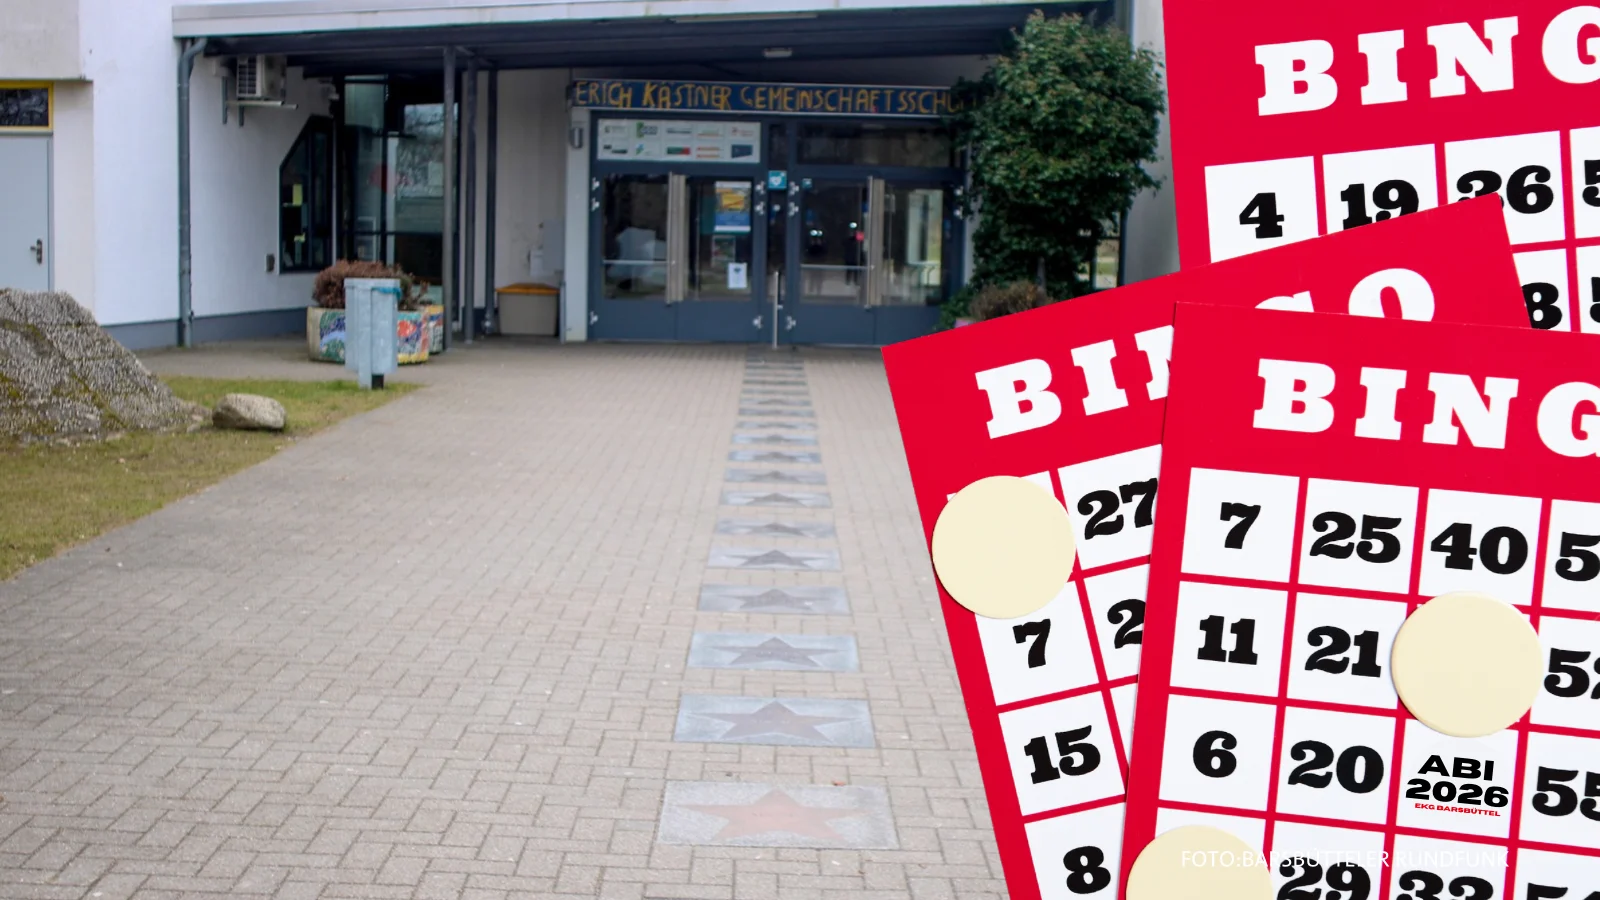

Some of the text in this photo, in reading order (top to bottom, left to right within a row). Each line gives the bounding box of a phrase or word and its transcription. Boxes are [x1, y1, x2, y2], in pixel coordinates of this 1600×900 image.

[575, 80, 632, 109] ERICH
[1239, 192, 1284, 239] 4
[1340, 179, 1419, 230] 19
[1077, 477, 1158, 540] 27
[1220, 502, 1261, 550] 7
[1309, 511, 1402, 564] 25
[1430, 522, 1528, 575] 40
[1012, 618, 1051, 669] 7
[1197, 614, 1258, 666] 11
[1304, 625, 1382, 678] 21
[1023, 725, 1101, 785] 15
[1192, 730, 1237, 778] 6
[1287, 740, 1385, 794] 20
[1417, 755, 1495, 781] ABI
[1405, 777, 1509, 808] 2026
[1414, 802, 1501, 817] EKG BARSBÜTTEL
[1063, 845, 1111, 895] 8
[1276, 856, 1371, 900] 29
